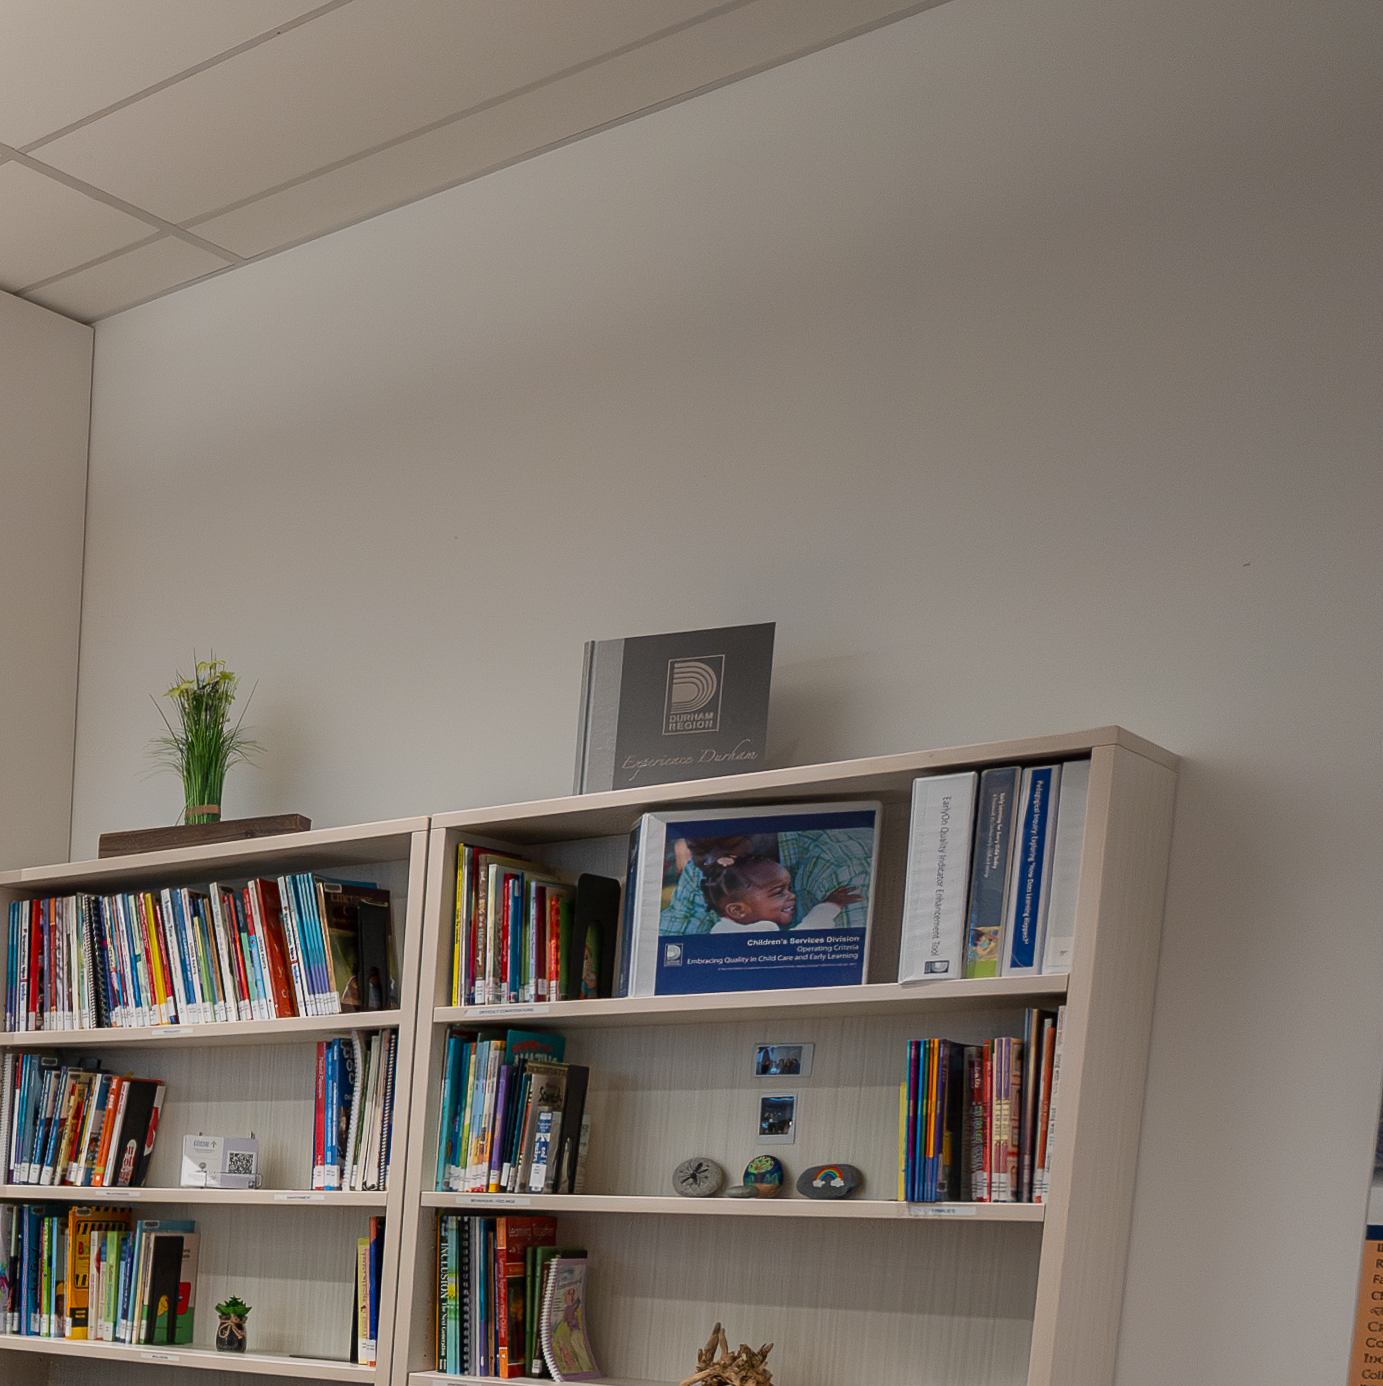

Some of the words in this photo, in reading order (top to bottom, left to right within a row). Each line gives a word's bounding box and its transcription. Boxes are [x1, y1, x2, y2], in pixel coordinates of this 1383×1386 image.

[668, 720, 713, 731] REGION
[669, 711, 714, 723] DURHAM
[698, 738, 758, 764] Durham
[937, 827, 949, 852] Quality
[936, 854, 948, 887] Indicator
[932, 889, 945, 937] Enhancement
[747, 938, 787, 947] Children's
[789, 937, 824, 945] Services
[826, 935, 860, 944] Division
[796, 945, 833, 953] Operating
[834, 943, 859, 951] Criteria
[930, 937, 941, 957] Tool
[686, 956, 723, 966] Embracing
[724, 956, 749, 965] Quality
[758, 953, 777, 962] Child
[777, 953, 794, 962] Care
[794, 953, 808, 961] and
[809, 952, 827, 962] Early
[827, 951, 859, 961] Learning
[440, 1242, 449, 1299] INCLUSION
